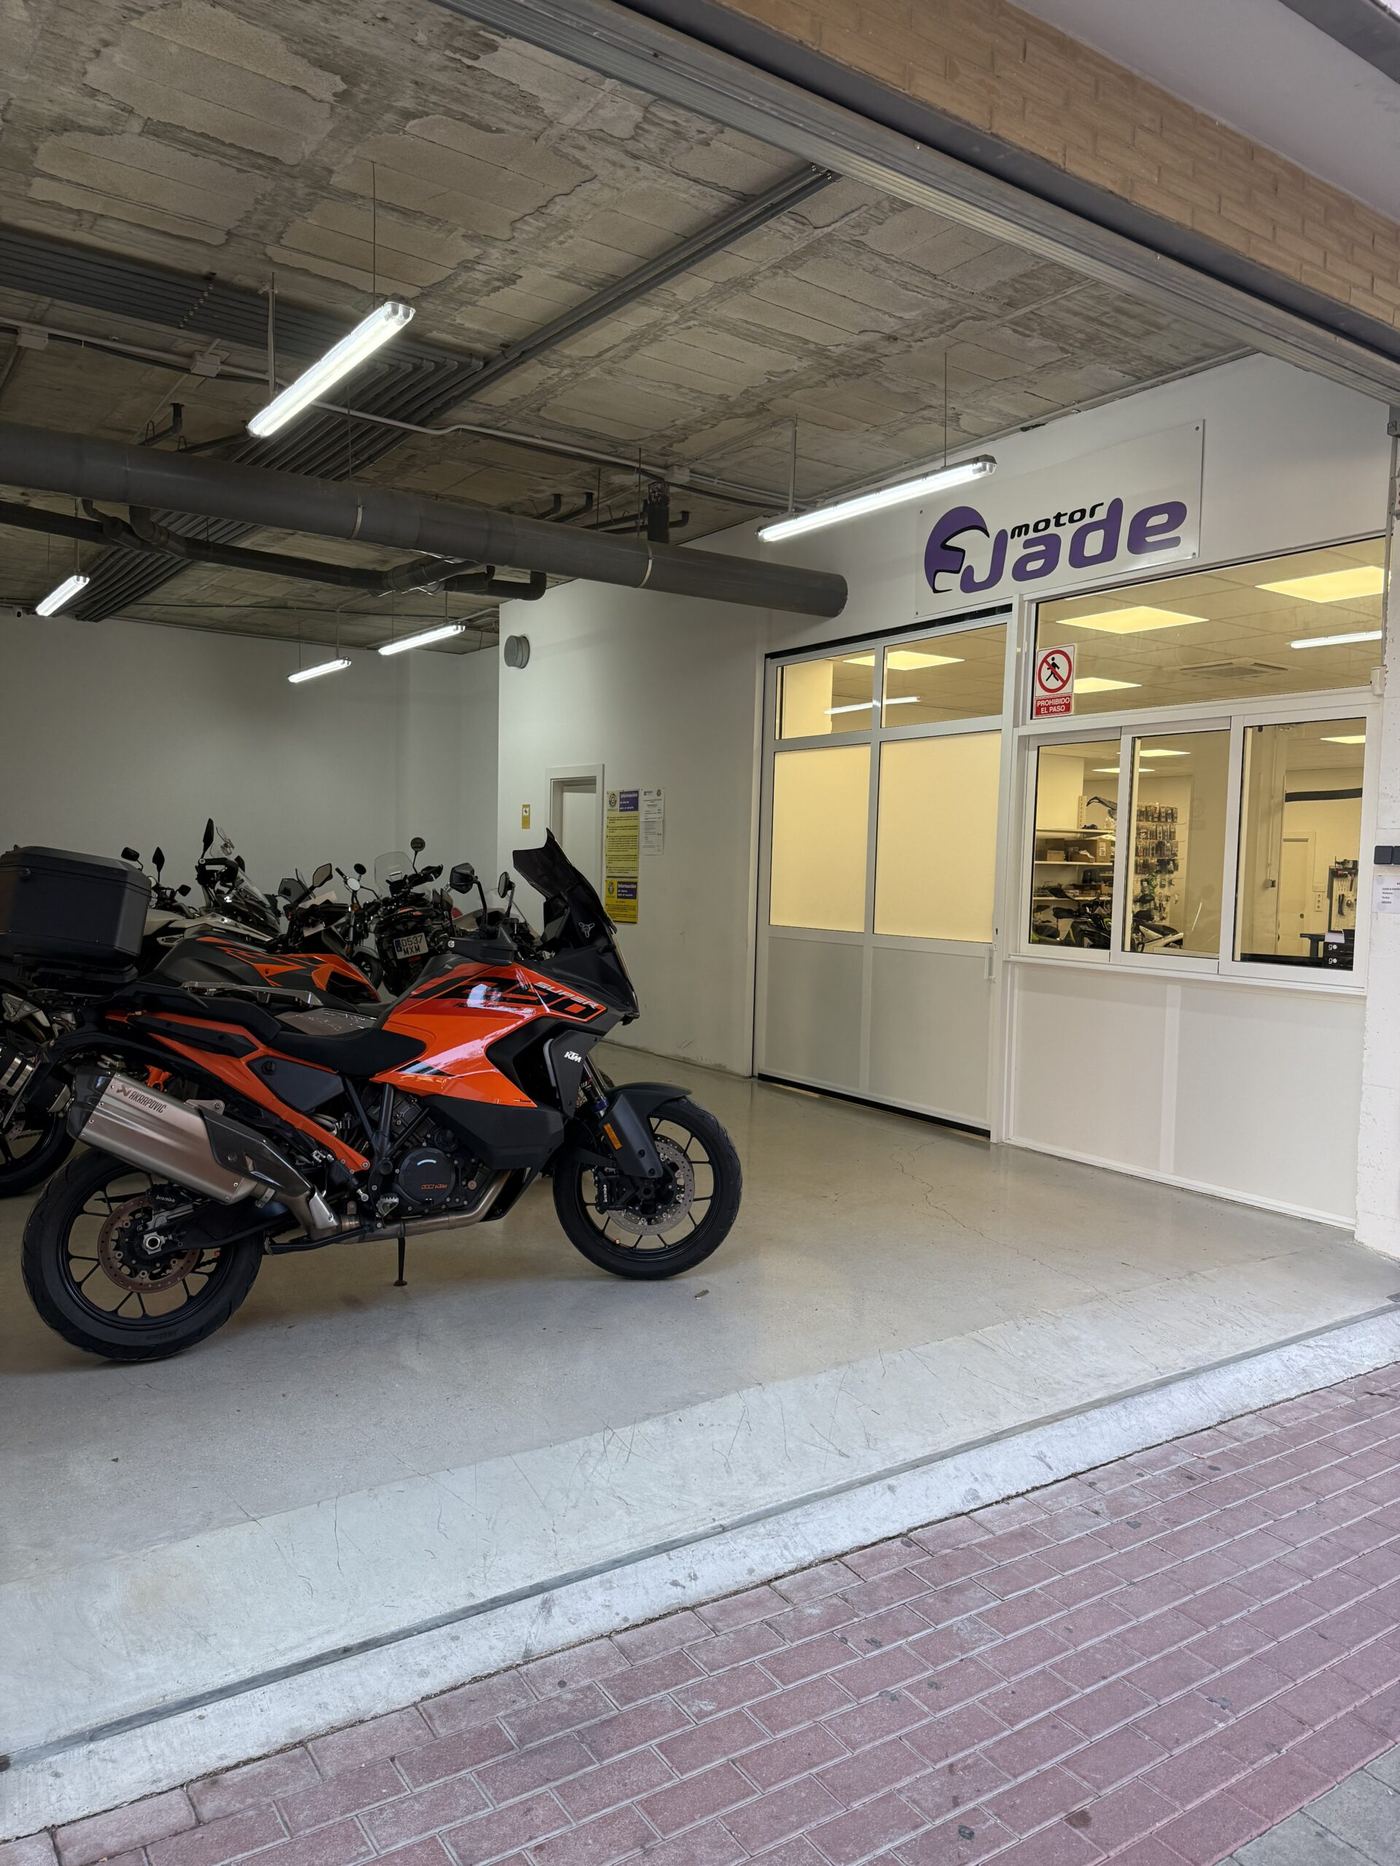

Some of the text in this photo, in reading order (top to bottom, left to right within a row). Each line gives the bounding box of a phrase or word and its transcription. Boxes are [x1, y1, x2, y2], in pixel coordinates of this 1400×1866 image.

[1010, 502, 1104, 540] motor
[960, 497, 1187, 594] Jade
[1036, 697, 1070, 708] PROHIBIDO
[1040, 704, 1066, 714] EL PASO
[563, 1050, 582, 1063] KTM
